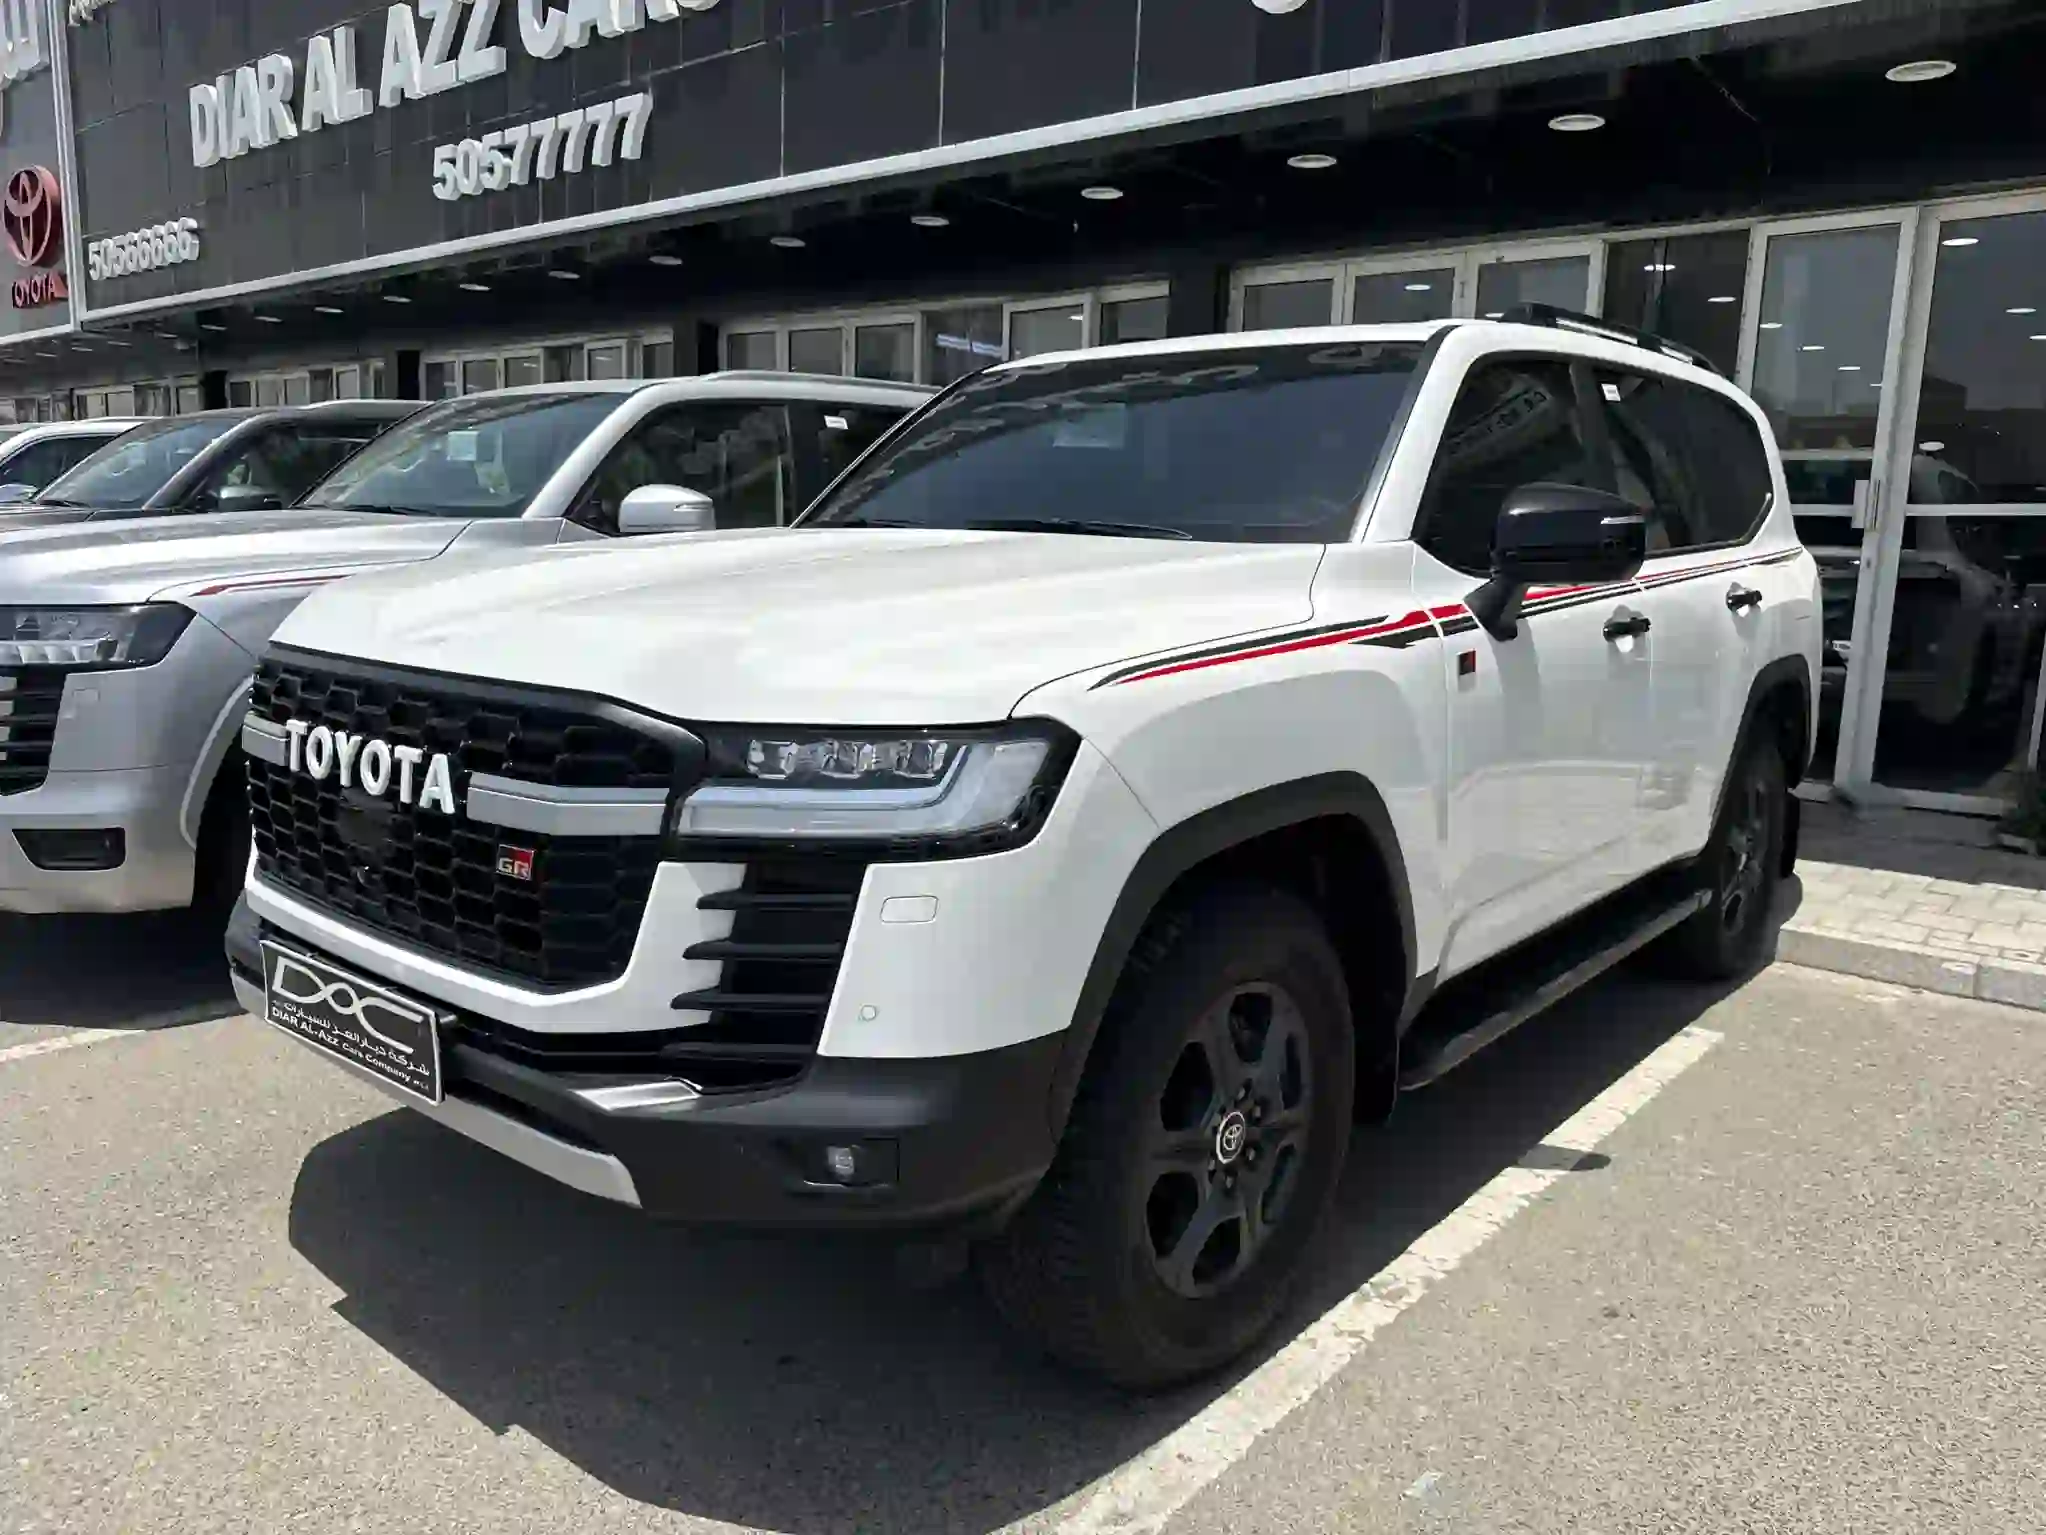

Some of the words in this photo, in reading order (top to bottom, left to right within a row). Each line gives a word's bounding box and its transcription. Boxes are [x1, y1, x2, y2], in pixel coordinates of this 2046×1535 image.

[189, 54, 297, 168] DIAR
[302, 26, 373, 130] AL
[379, 0, 507, 107] AZZ
[432, 92, 654, 200] 50577777
[88, 217, 200, 281] 50566666
[12, 272, 65, 309] TOYOTA
[286, 719, 455, 814] TOYOTA
[498, 856, 530, 879] GR
[272, 1006, 299, 1028] DIAR
[365, 1053, 411, 1083] Company
